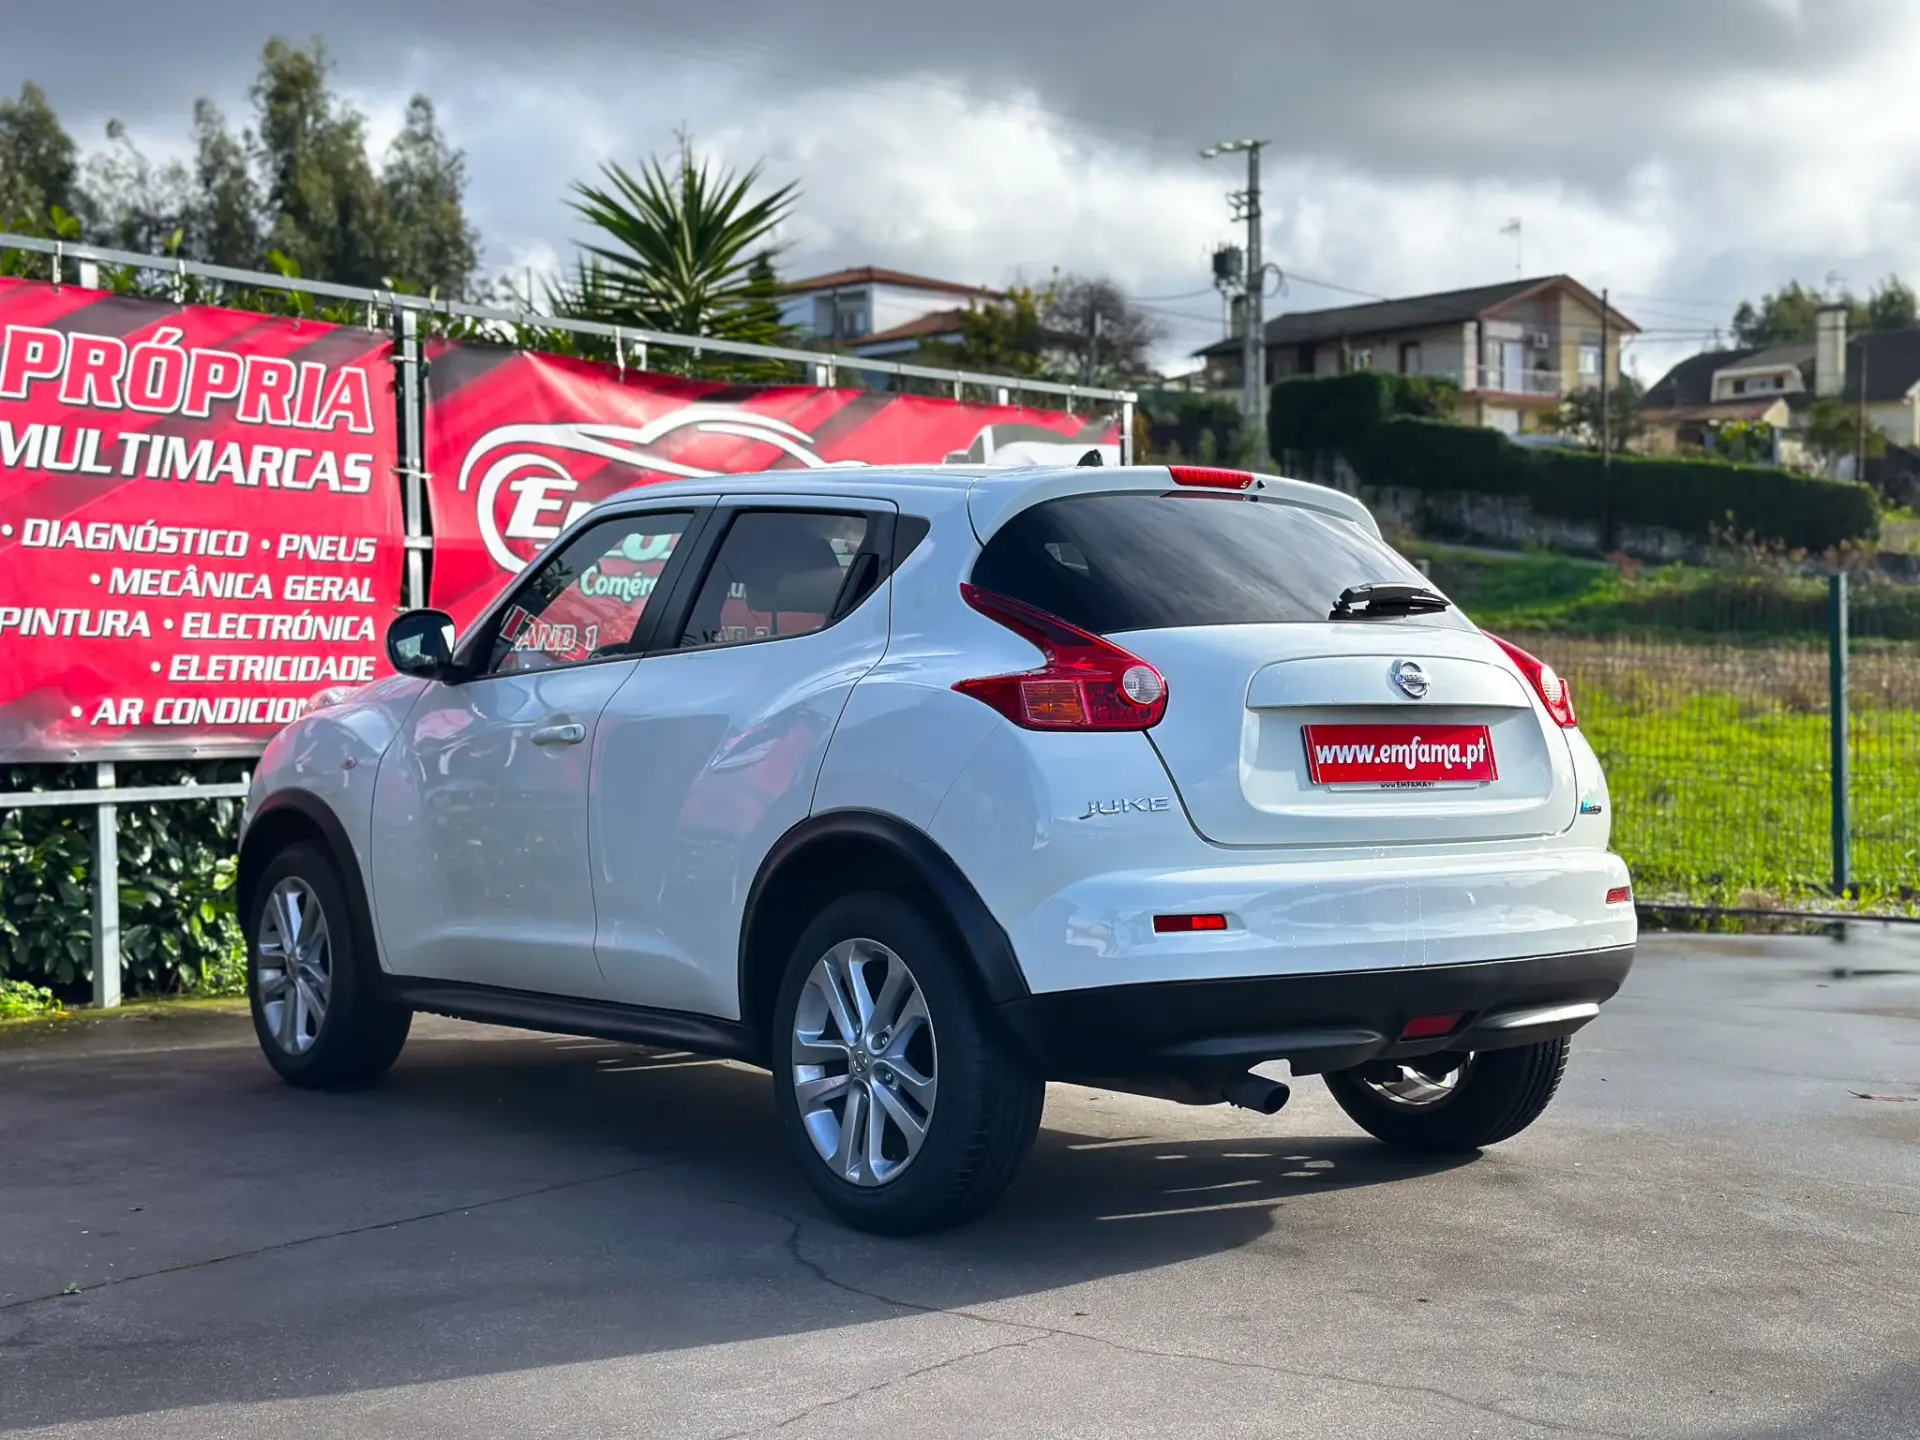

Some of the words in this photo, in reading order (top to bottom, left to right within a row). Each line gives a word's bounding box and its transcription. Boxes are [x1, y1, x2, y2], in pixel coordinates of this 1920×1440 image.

[0, 325, 375, 434] PRÓPRIA
[0, 420, 375, 493] MULTIMARCAS
[21, 519, 250, 558] DIAGNÓSTICO
[277, 533, 378, 563] PNEUS
[108, 564, 273, 601] MECÂNICA
[283, 575, 376, 603] GERAL
[0, 606, 151, 638] PINTURA
[181, 609, 376, 642] ELECTRÓNICA
[168, 654, 377, 683] ELETRICIDADE
[90, 697, 145, 726] AR
[1315, 735, 1486, 770] www.emfama.pt
[1078, 796, 1170, 820] JUKE
